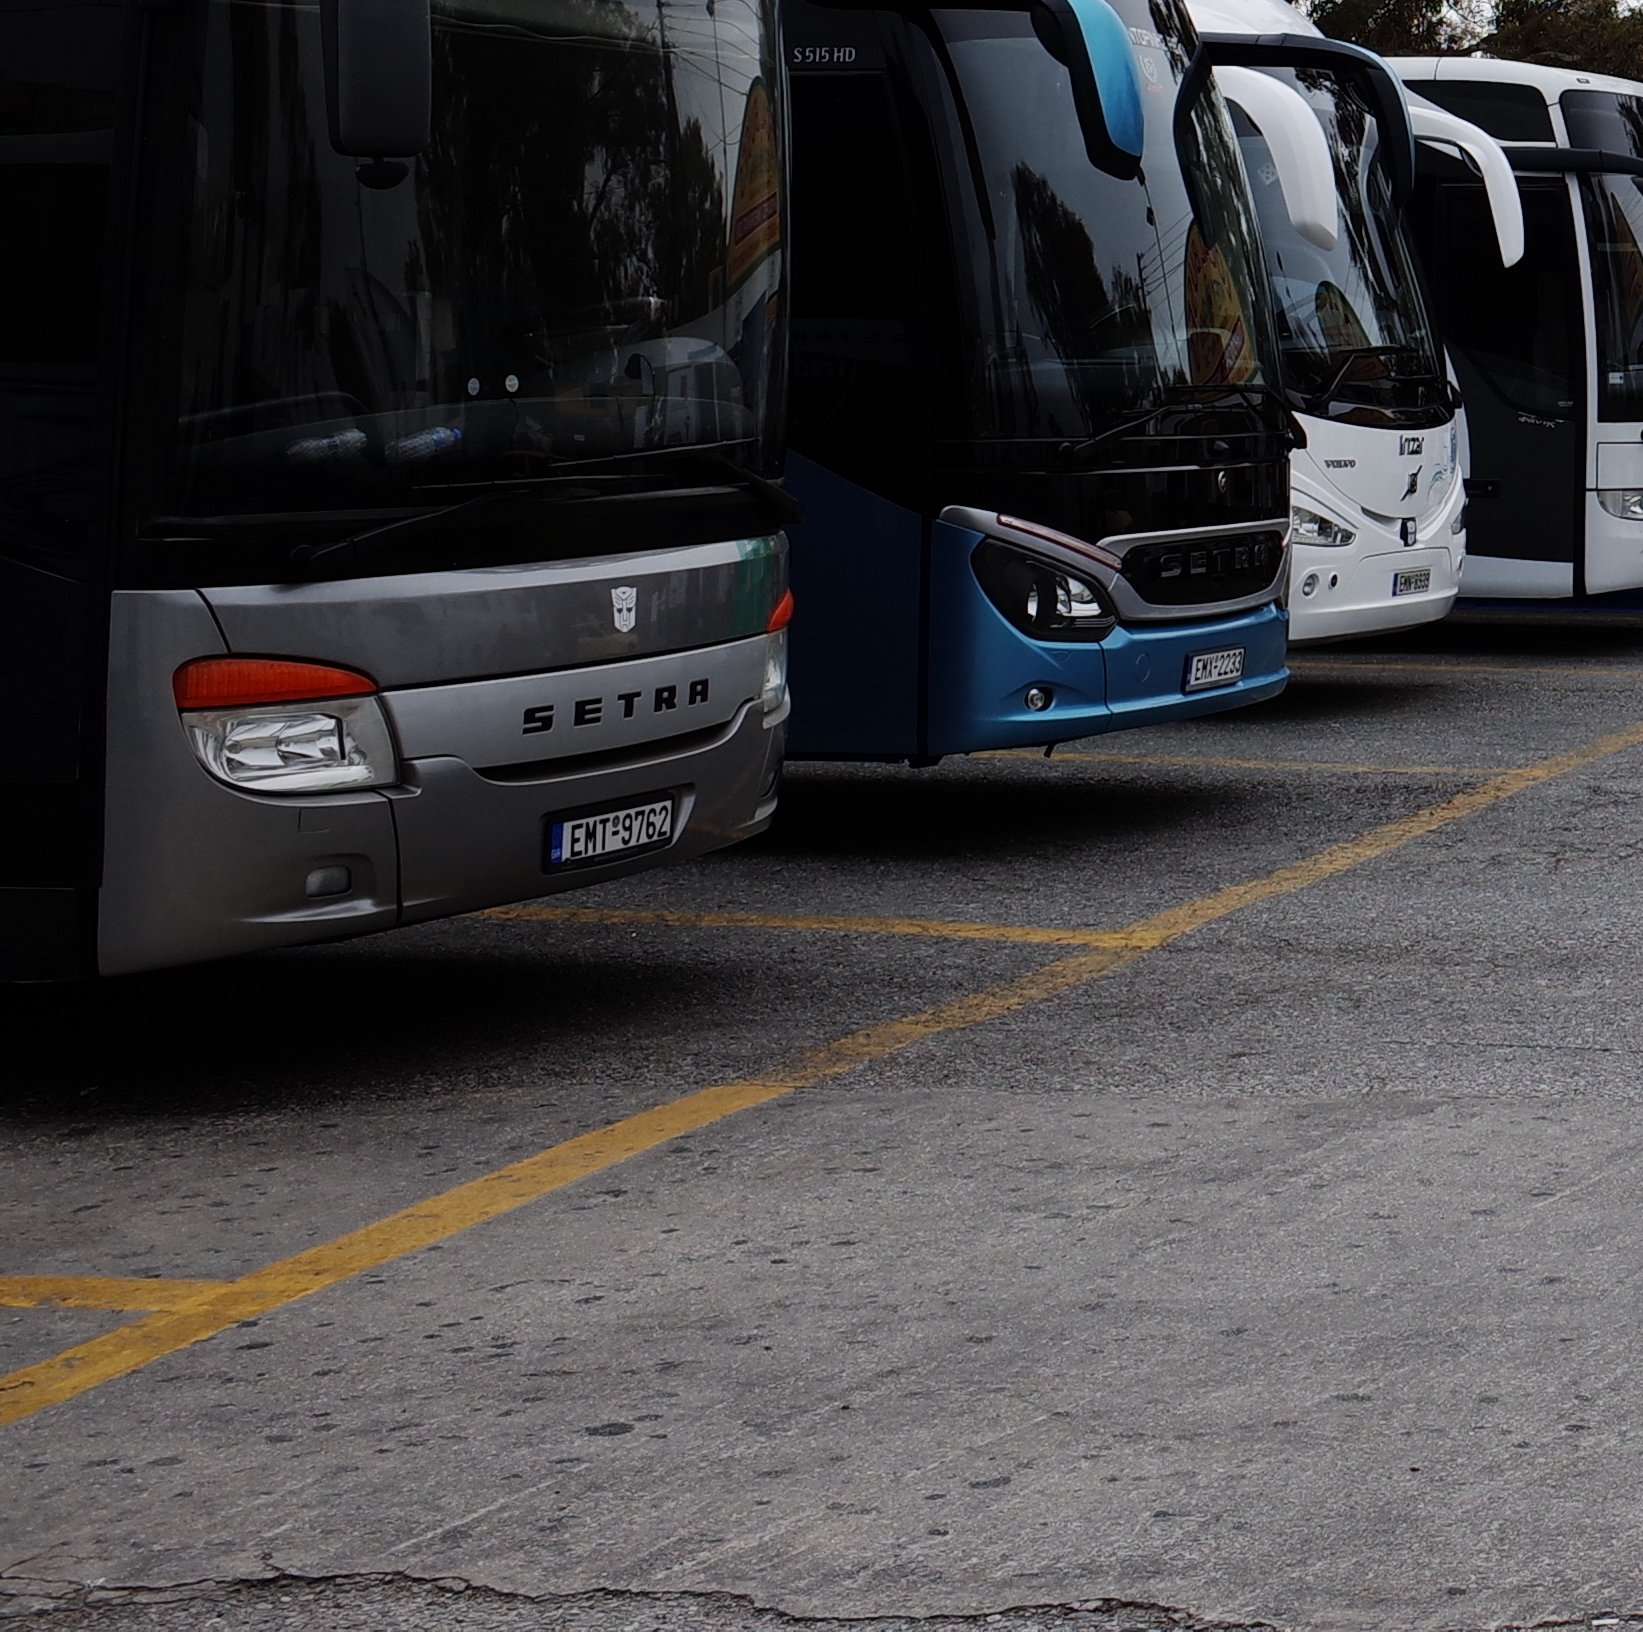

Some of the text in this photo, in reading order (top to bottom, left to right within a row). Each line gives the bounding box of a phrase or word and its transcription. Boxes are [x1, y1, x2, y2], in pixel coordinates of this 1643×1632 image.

[793, 46, 856, 63] S 515 HD
[1324, 459, 1356, 468] VOLVO
[1160, 543, 1265, 578] SETRA
[522, 678, 709, 735] SETRA
[570, 805, 670, 858] EMT-9762
